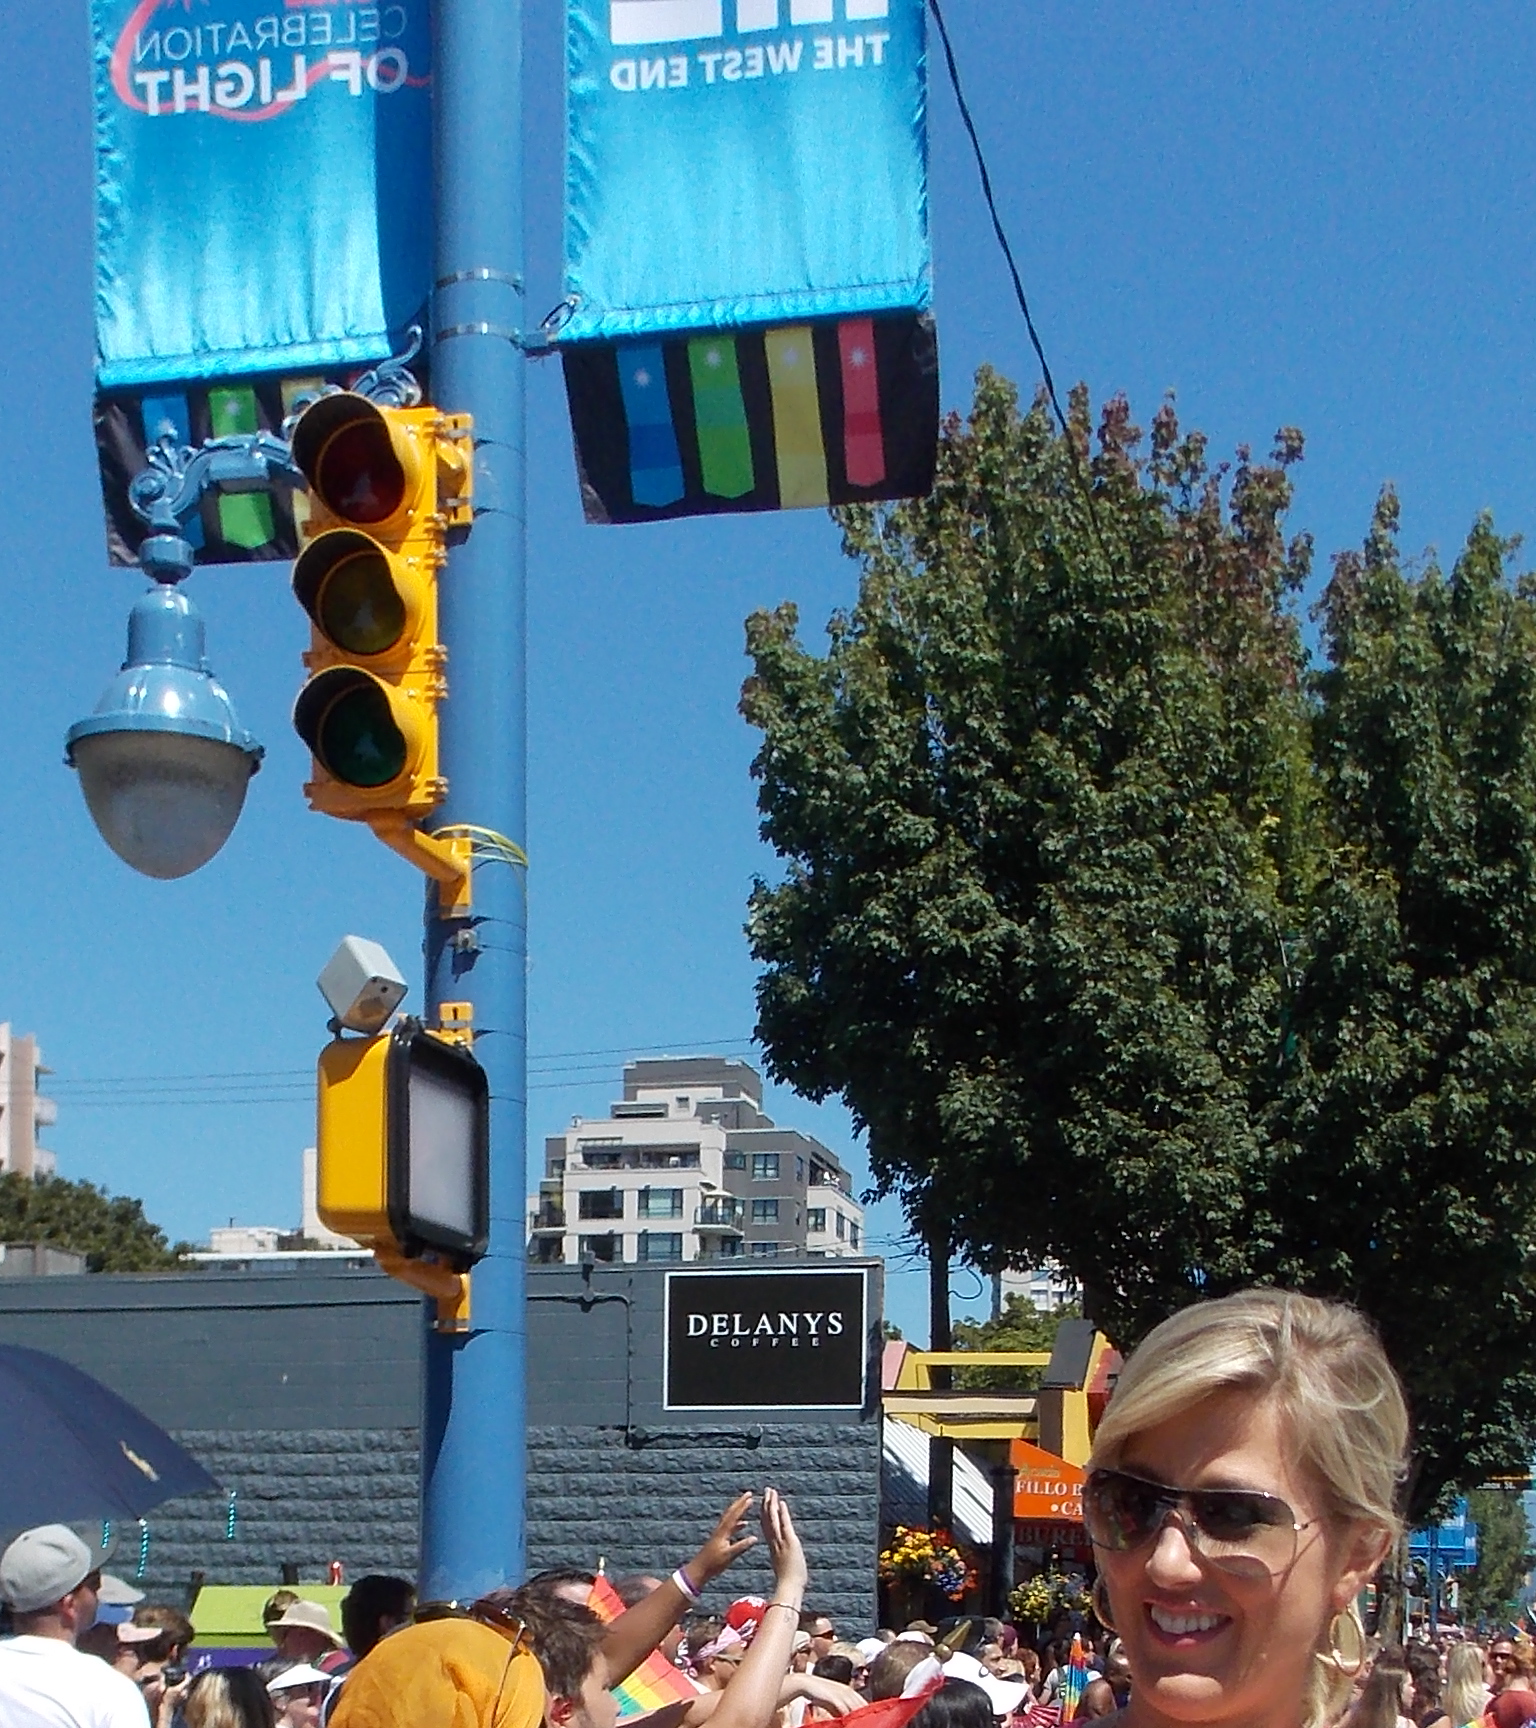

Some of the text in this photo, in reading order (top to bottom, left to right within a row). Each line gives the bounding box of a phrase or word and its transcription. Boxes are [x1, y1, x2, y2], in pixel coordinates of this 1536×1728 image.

[686, 1312, 843, 1336] DELANYS
[710, 1337, 820, 1348] COFFEE
[1016, 1480, 1067, 1496] FILLO
